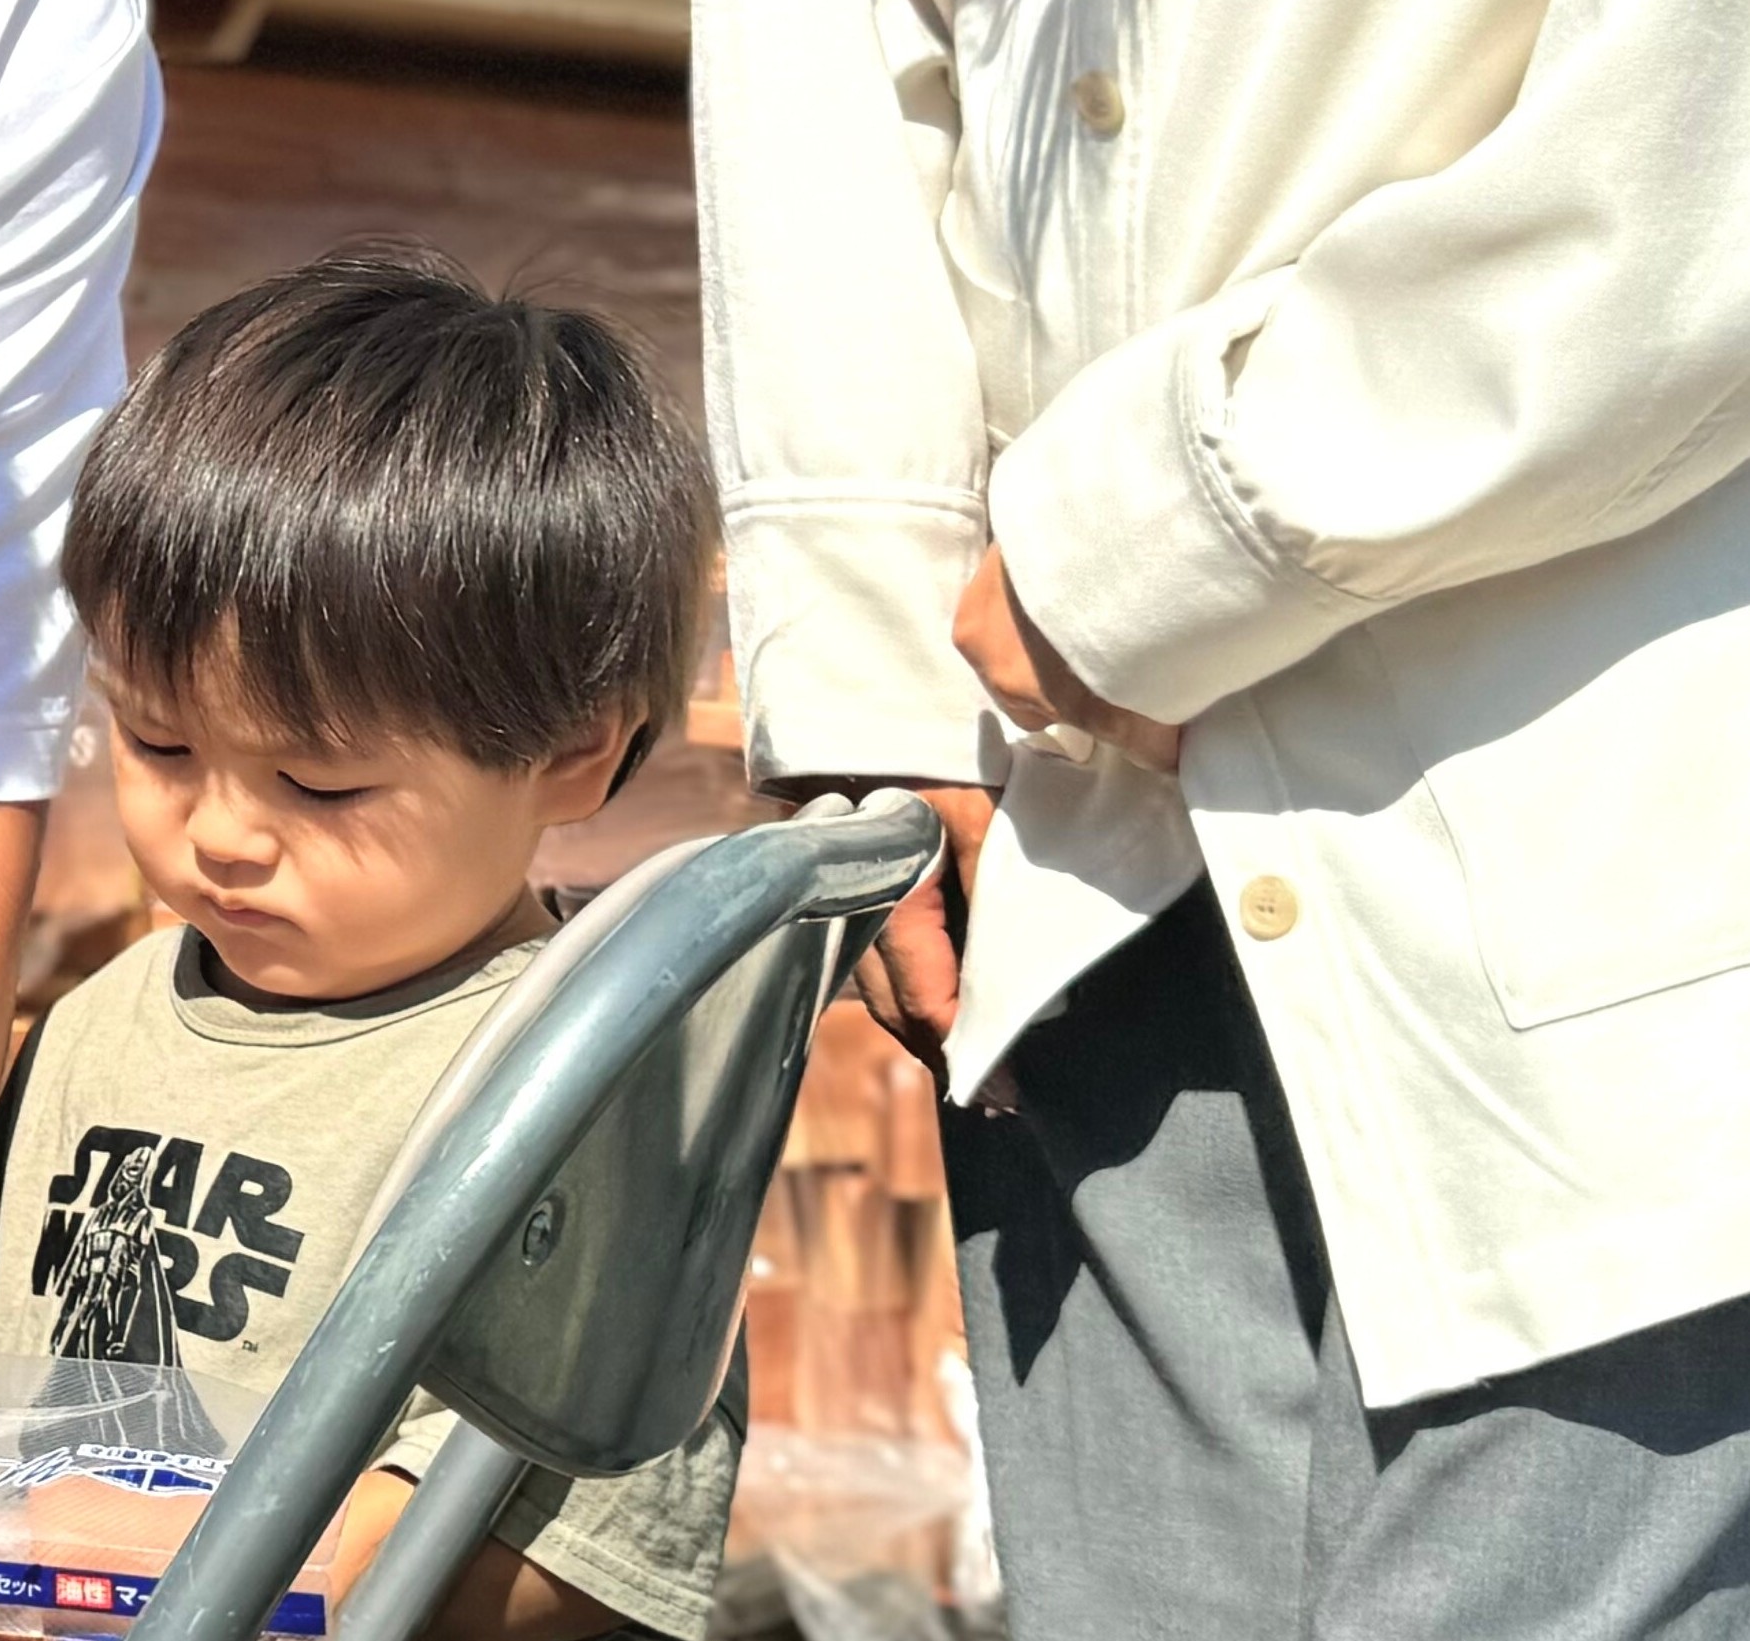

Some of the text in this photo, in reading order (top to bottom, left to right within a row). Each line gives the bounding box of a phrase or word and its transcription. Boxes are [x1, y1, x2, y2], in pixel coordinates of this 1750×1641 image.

[49, 1125, 304, 1263] STAR
[32, 1208, 291, 1342] WRS
[57, 1576, 111, 1607] 油性
